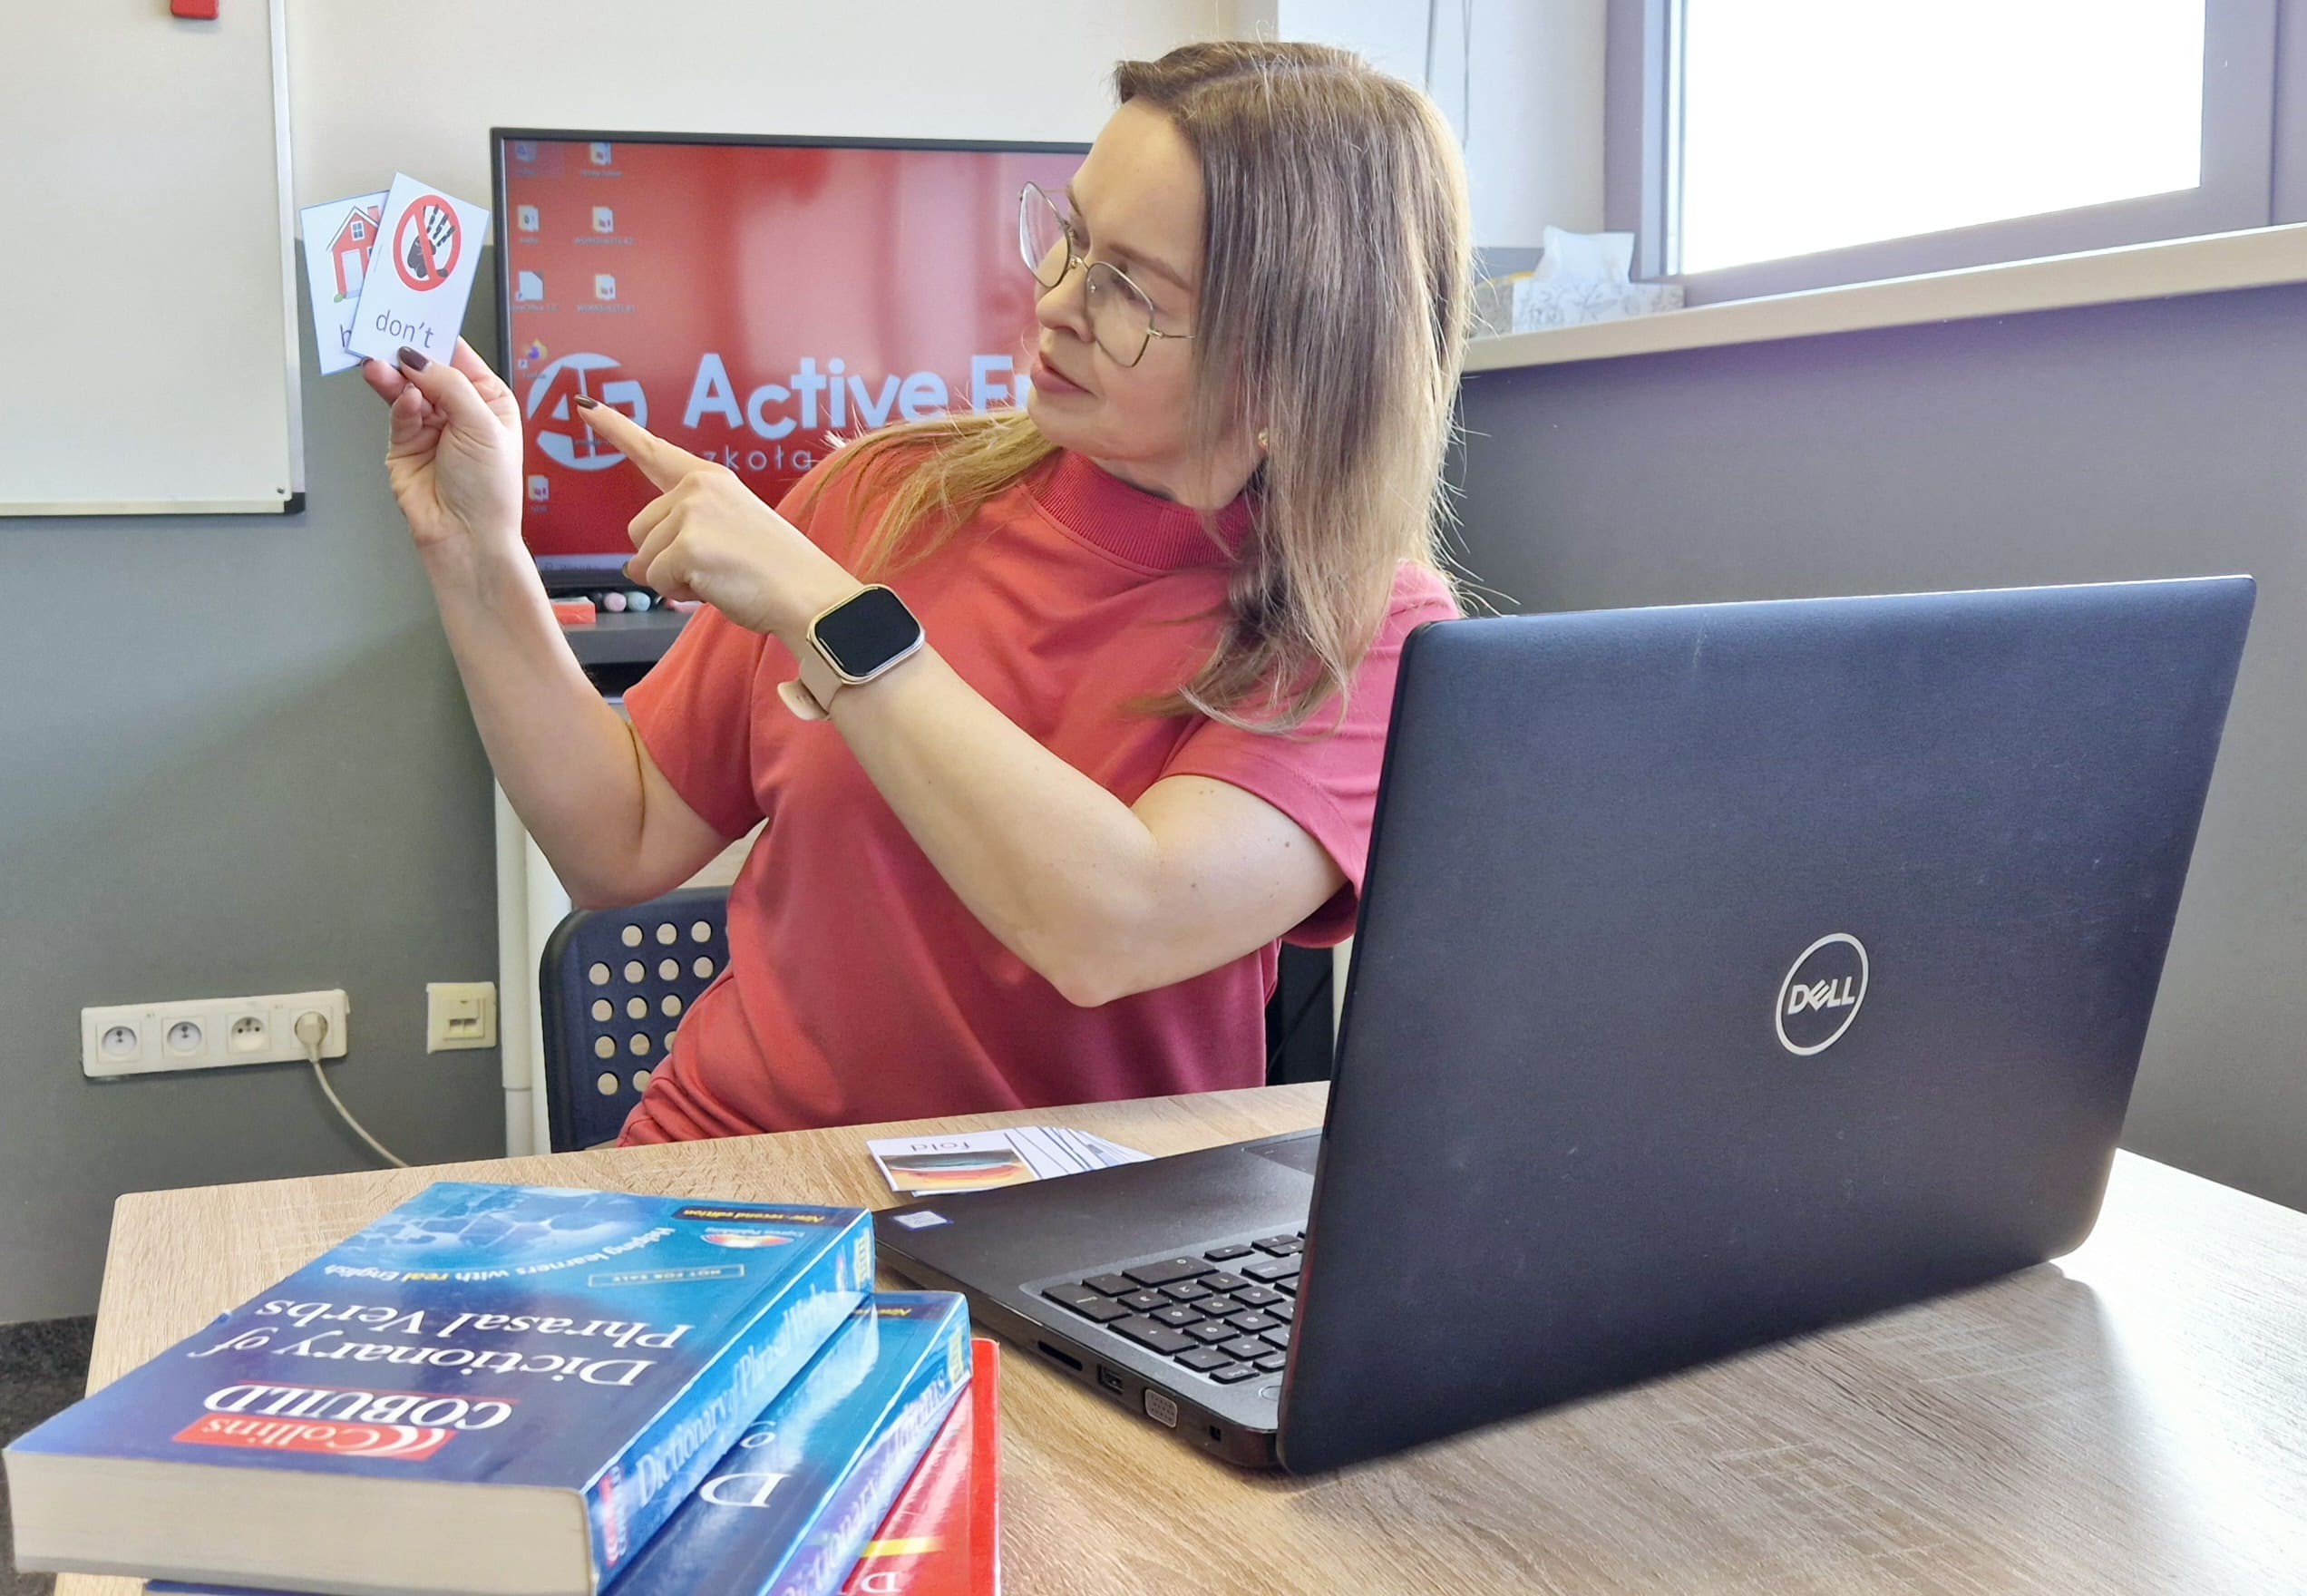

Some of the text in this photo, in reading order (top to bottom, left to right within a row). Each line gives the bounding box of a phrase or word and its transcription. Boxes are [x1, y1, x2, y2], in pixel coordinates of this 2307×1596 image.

[375, 308, 434, 349] don't
[683, 353, 949, 441] Active
[1787, 976, 1855, 1015] DELL
[324, 1264, 399, 1282] English
[401, 1272, 450, 1282] real
[454, 1270, 510, 1282] with
[515, 1251, 609, 1275] learners
[255, 1299, 695, 1348] Phrasal Verbs
[187, 1327, 657, 1387] Dictionary of
[203, 1384, 516, 1431] COBUILD
[201, 1417, 381, 1449] Collins
